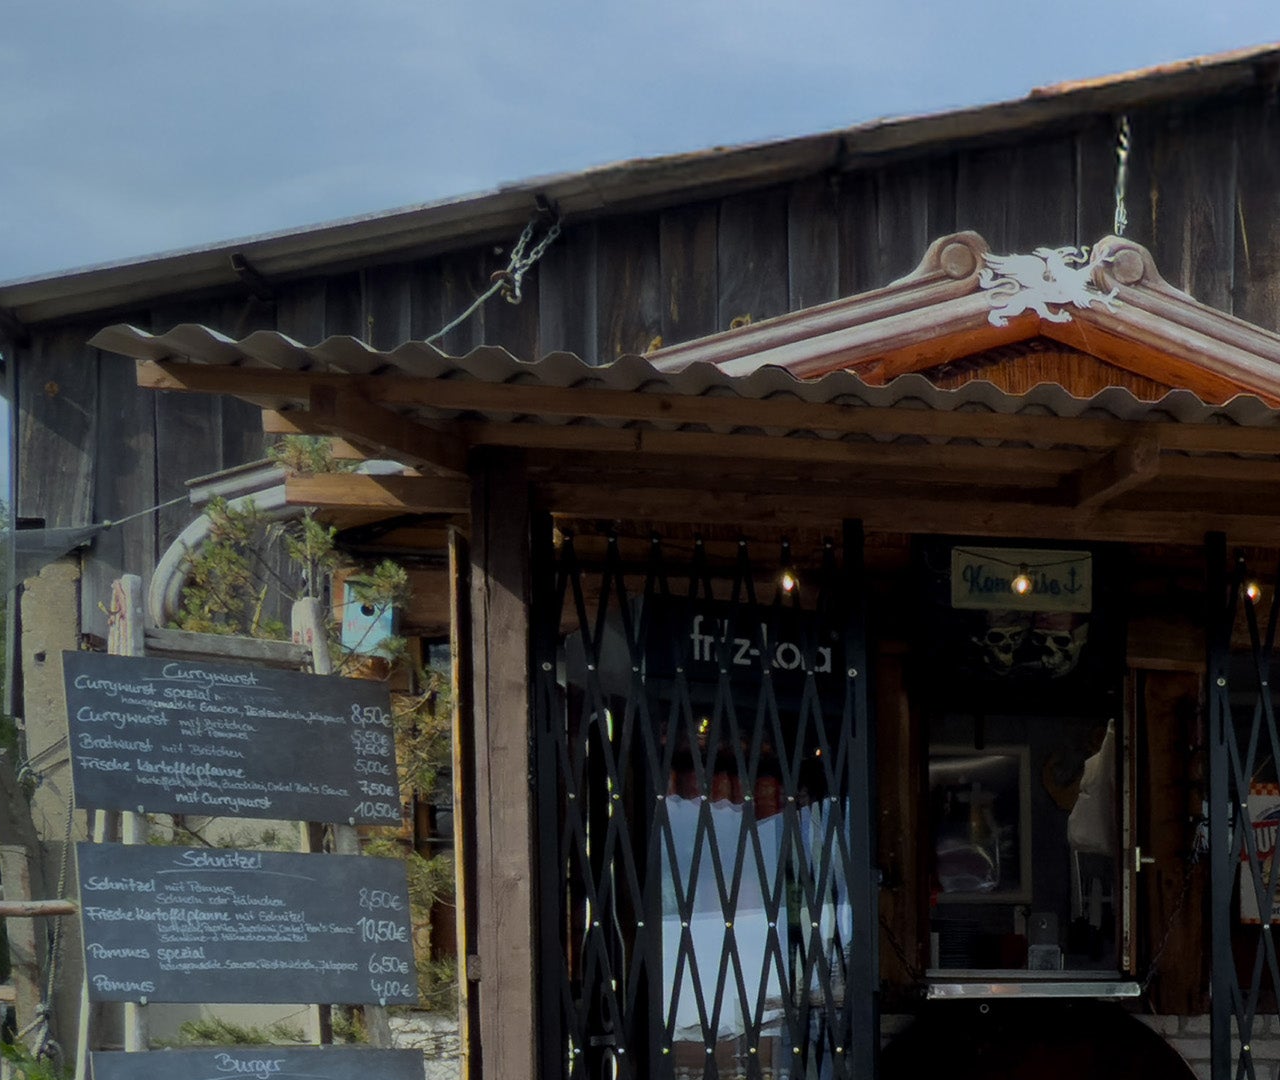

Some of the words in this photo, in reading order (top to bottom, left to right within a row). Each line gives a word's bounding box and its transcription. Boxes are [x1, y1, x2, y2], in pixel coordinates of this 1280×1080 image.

[74, 675, 156, 696] Currywurst
[164, 683, 212, 701] spezial
[162, 663, 258, 688] Currywurst
[76, 707, 169, 729] Currywurst
[351, 704, 393, 728] 8,50€
[78, 733, 154, 753] Bratwurst
[354, 758, 392, 775] 5,00€
[76, 756, 133, 771] Frische
[358, 780, 396, 797] 7,50€
[175, 791, 200, 804] mit
[202, 794, 273, 813] Currywurst
[354, 802, 402, 820] 10,50€
[173, 850, 262, 869] Schnitzel
[84, 877, 156, 892] Schnitzel
[358, 887, 404, 911] 8,50€
[85, 906, 132, 922] Frische
[356, 916, 409, 943] 10,50€
[87, 943, 151, 960] Pommes
[157, 946, 206, 963] spezial
[368, 953, 409, 975] 6,50€
[93, 974, 156, 993] Pommes
[370, 979, 414, 998] 4,00€
[214, 1053, 286, 1080] Burger
